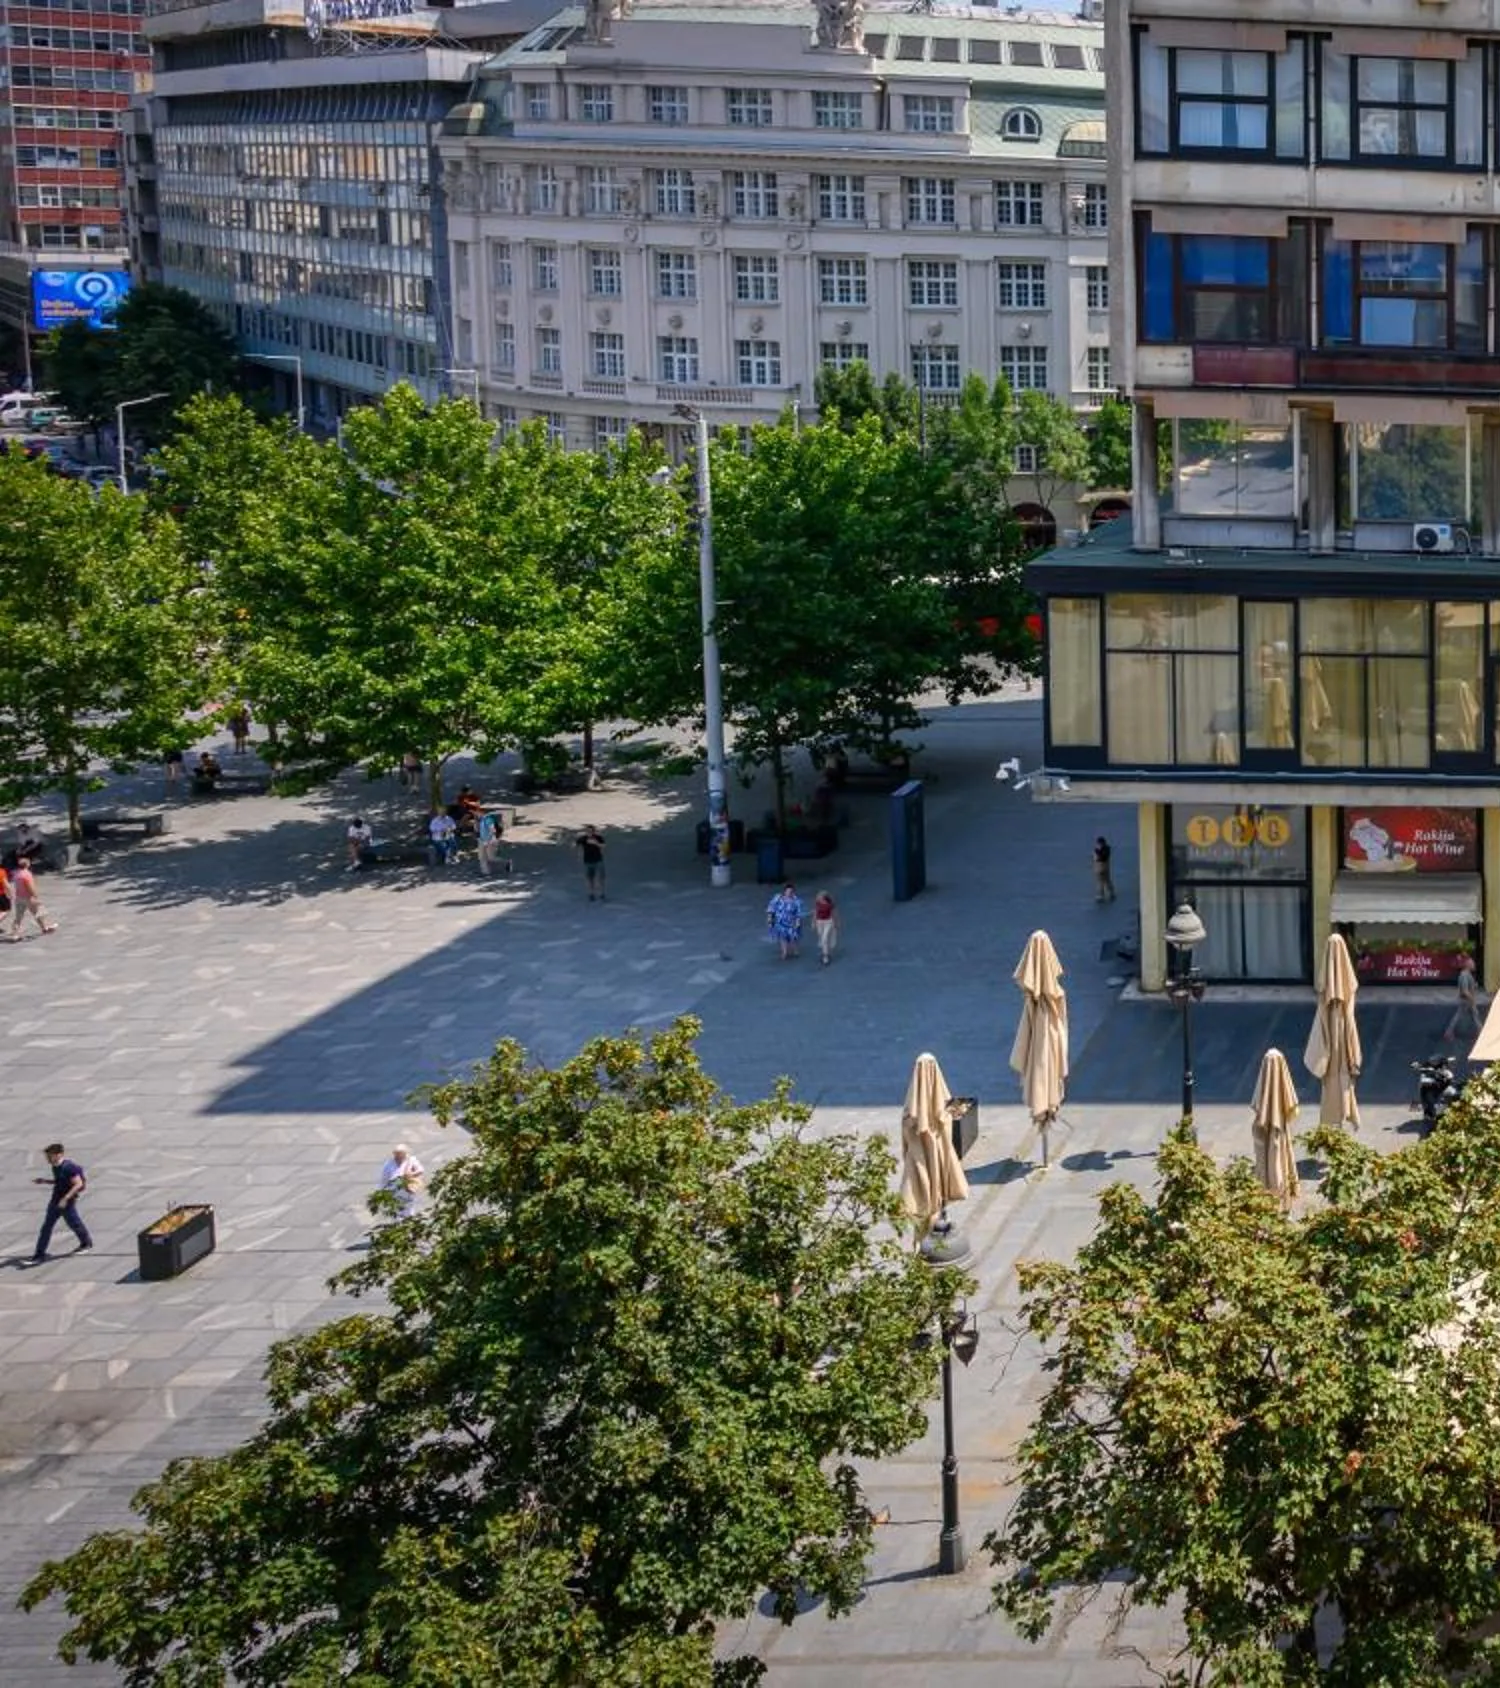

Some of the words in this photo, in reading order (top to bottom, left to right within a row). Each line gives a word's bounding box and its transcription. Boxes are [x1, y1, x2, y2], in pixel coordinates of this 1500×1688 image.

[1413, 829, 1455, 843] Rakija
[1405, 842, 1428, 854] Hot
[1432, 842, 1464, 855] Wine
[1394, 953, 1432, 967] Rakija
[1410, 967, 1441, 977] Wine
